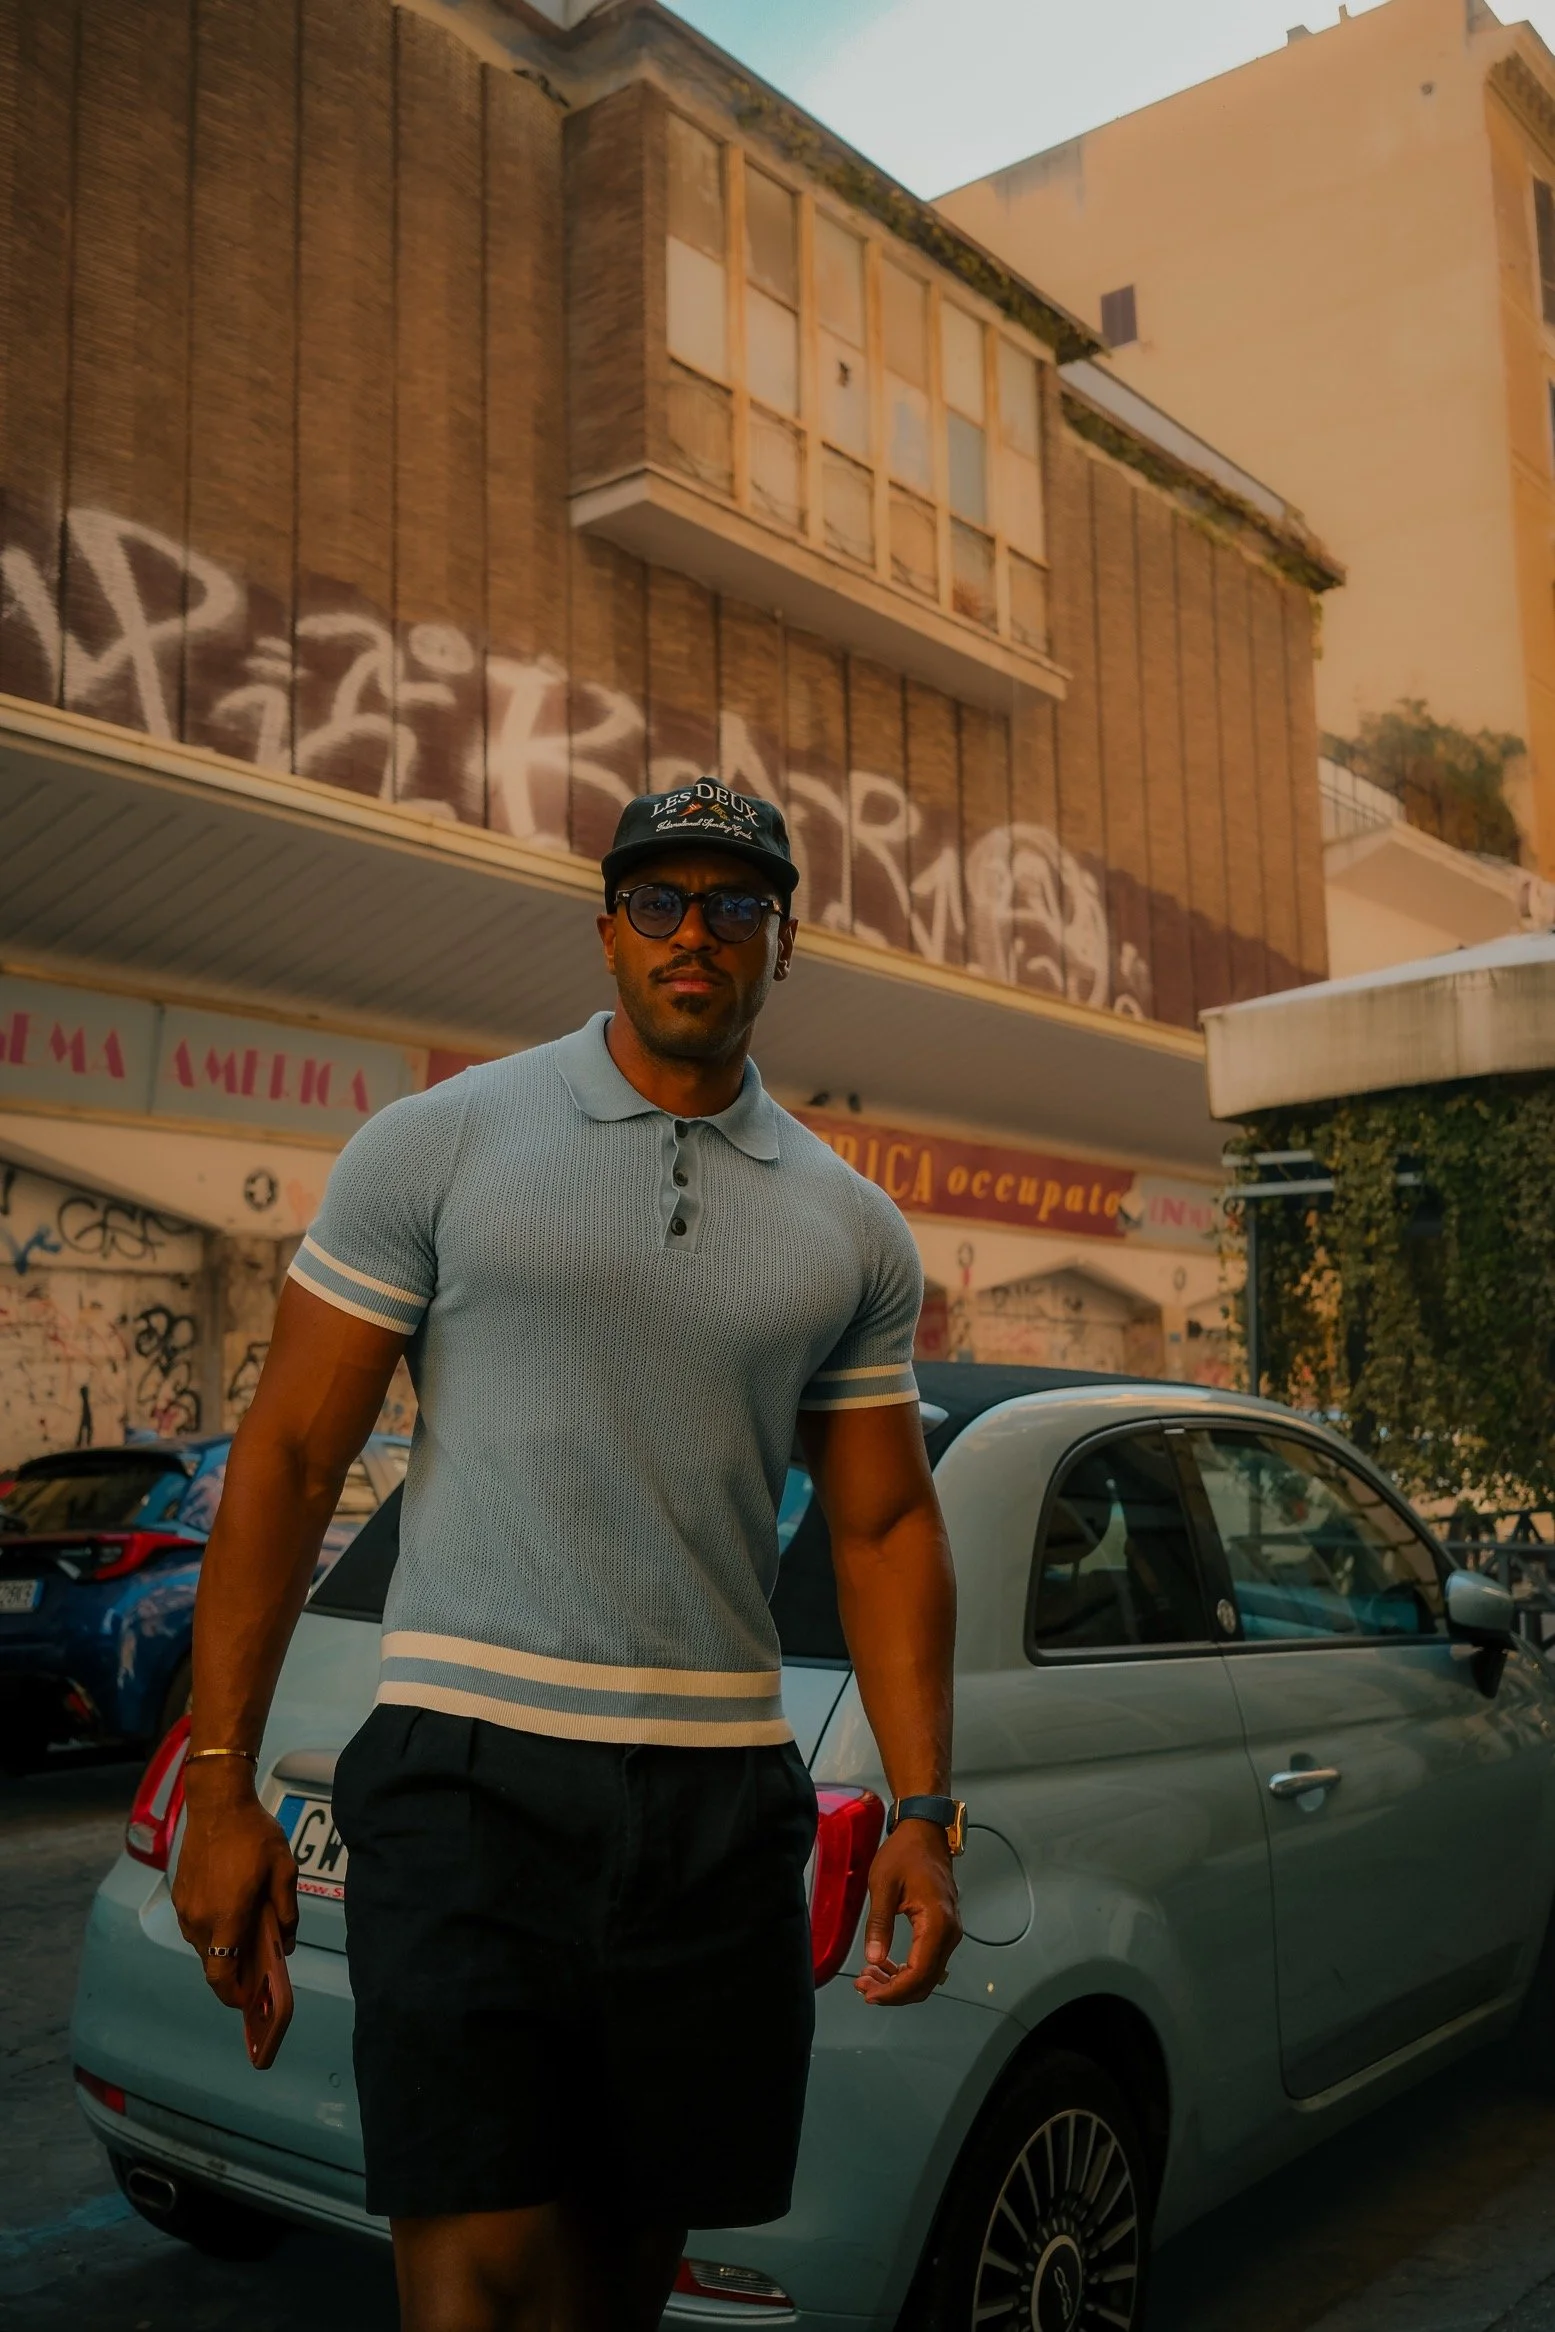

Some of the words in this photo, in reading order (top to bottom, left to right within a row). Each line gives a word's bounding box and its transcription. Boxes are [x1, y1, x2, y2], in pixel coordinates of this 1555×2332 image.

[651, 792, 691, 818] LES
[695, 783, 760, 828] DEUX
[656, 817, 703, 832] International
[702, 818, 732, 834] Sporting
[946, 1165, 1121, 1221] occupato
